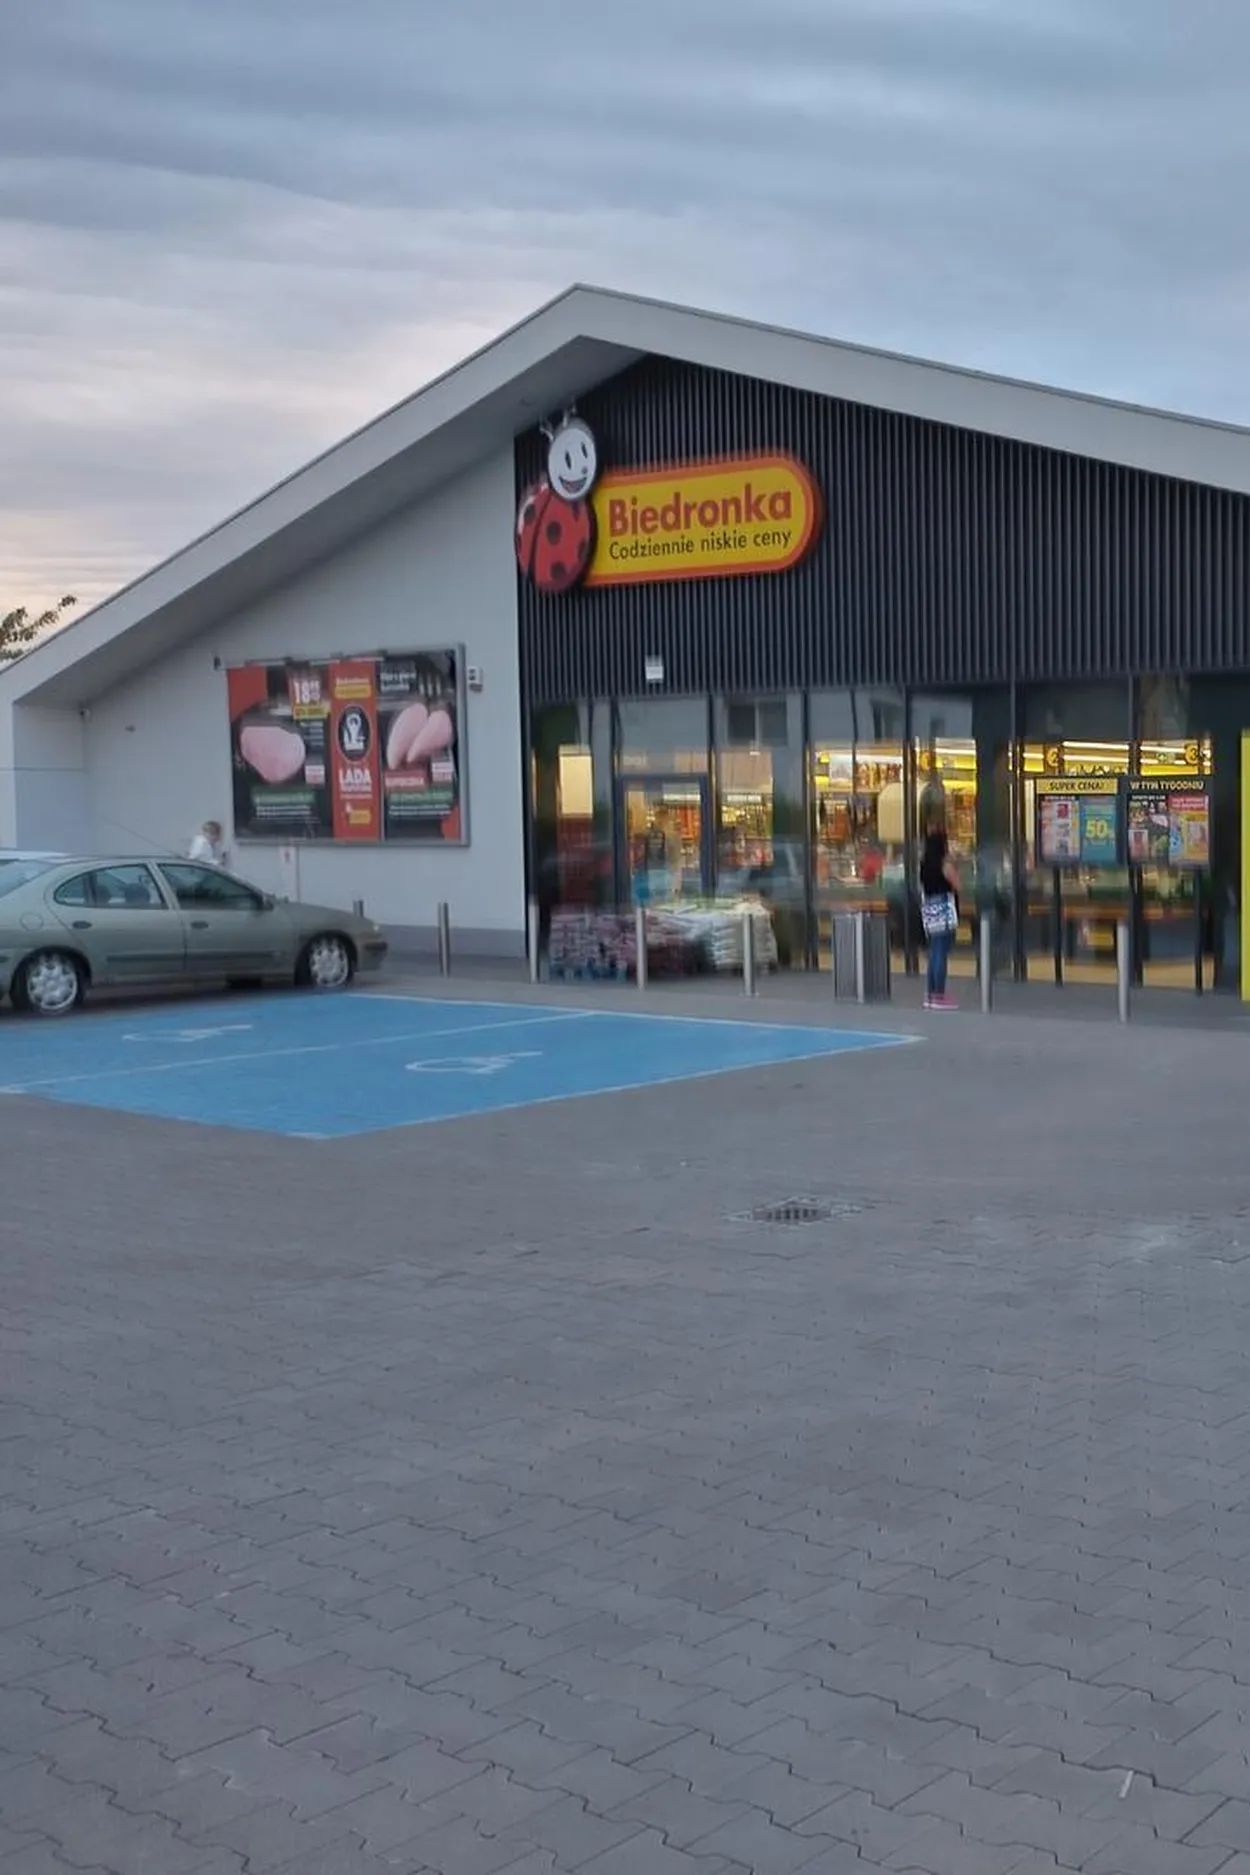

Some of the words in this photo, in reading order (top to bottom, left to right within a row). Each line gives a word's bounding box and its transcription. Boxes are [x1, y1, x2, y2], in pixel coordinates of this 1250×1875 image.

[609, 483, 792, 537] Biedronka
[609, 533, 694, 561] Codziennie
[701, 529, 747, 551] niskie
[753, 529, 792, 549] ceny
[1049, 781, 1076, 791] SUPER
[1160, 781, 1204, 791] TYGODNIU
